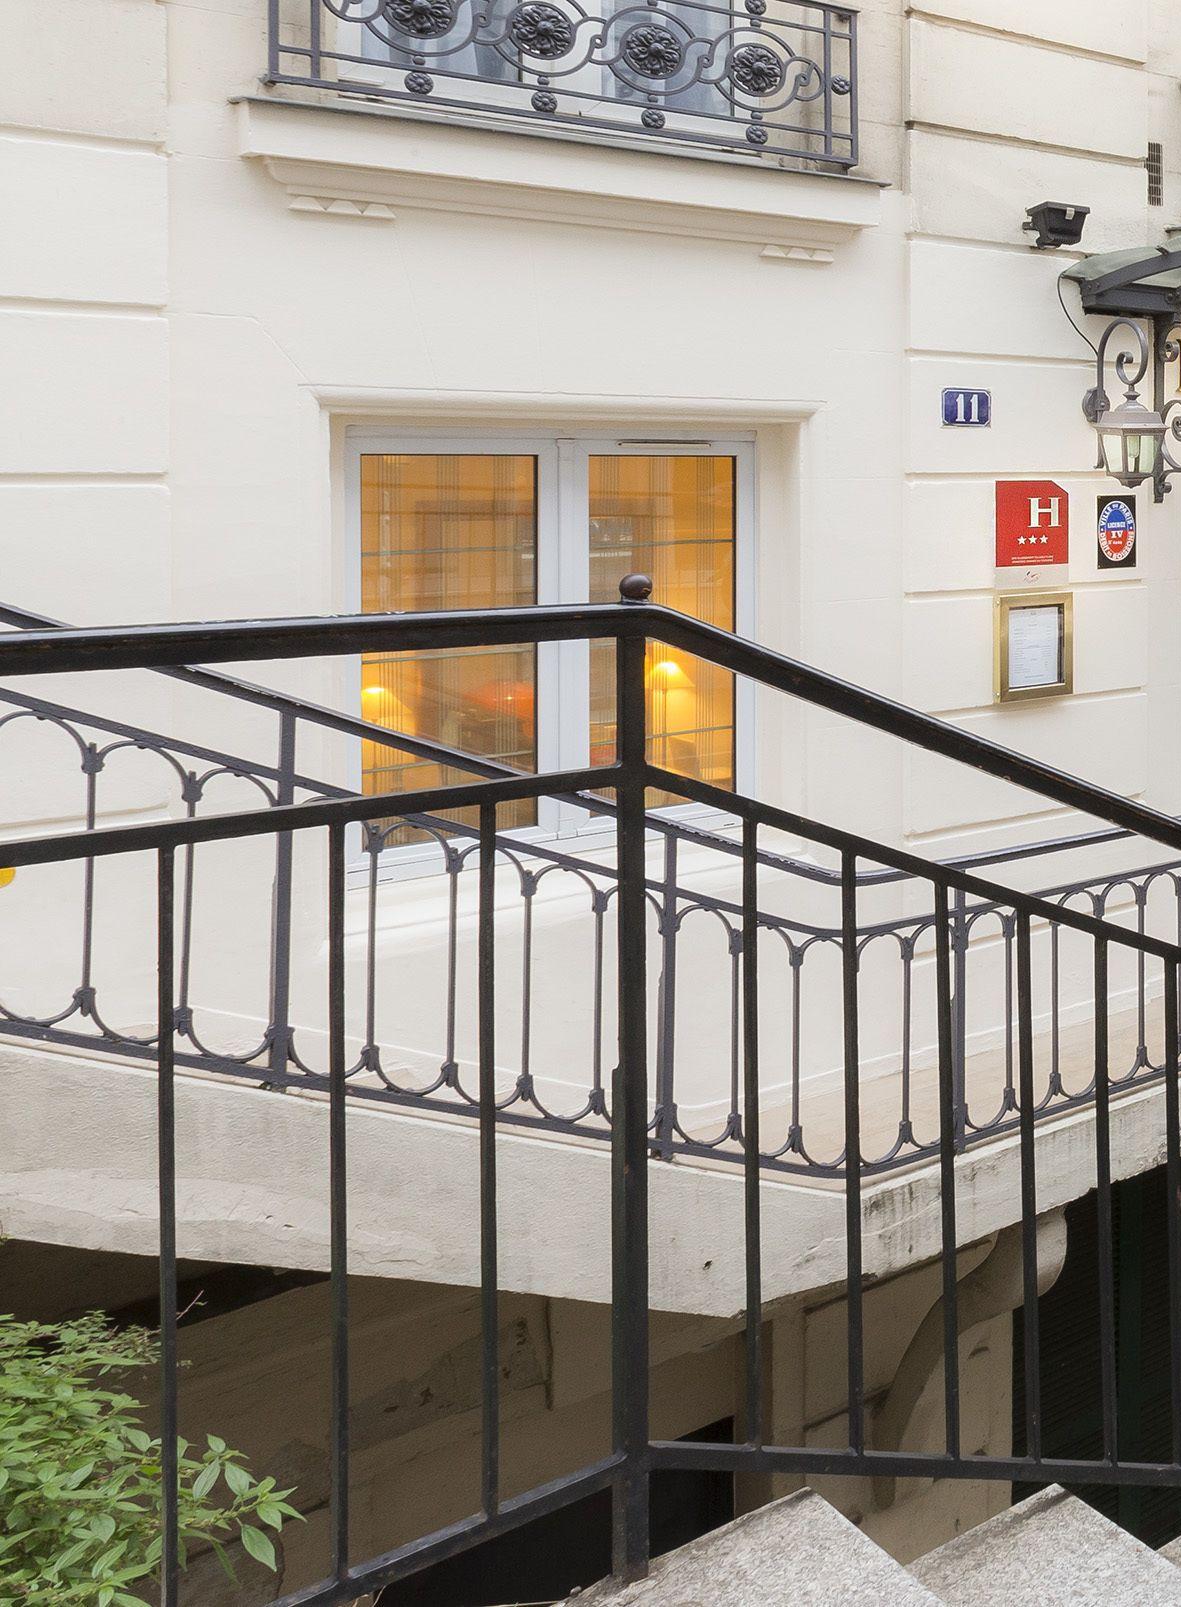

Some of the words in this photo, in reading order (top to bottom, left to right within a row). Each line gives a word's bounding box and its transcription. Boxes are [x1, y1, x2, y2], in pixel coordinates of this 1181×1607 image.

[954, 393, 980, 423] 11
[1026, 496, 1064, 528] H
[1100, 506, 1113, 526] VILLE
[1119, 503, 1134, 525] PARIS
[1110, 530, 1124, 539] IV
